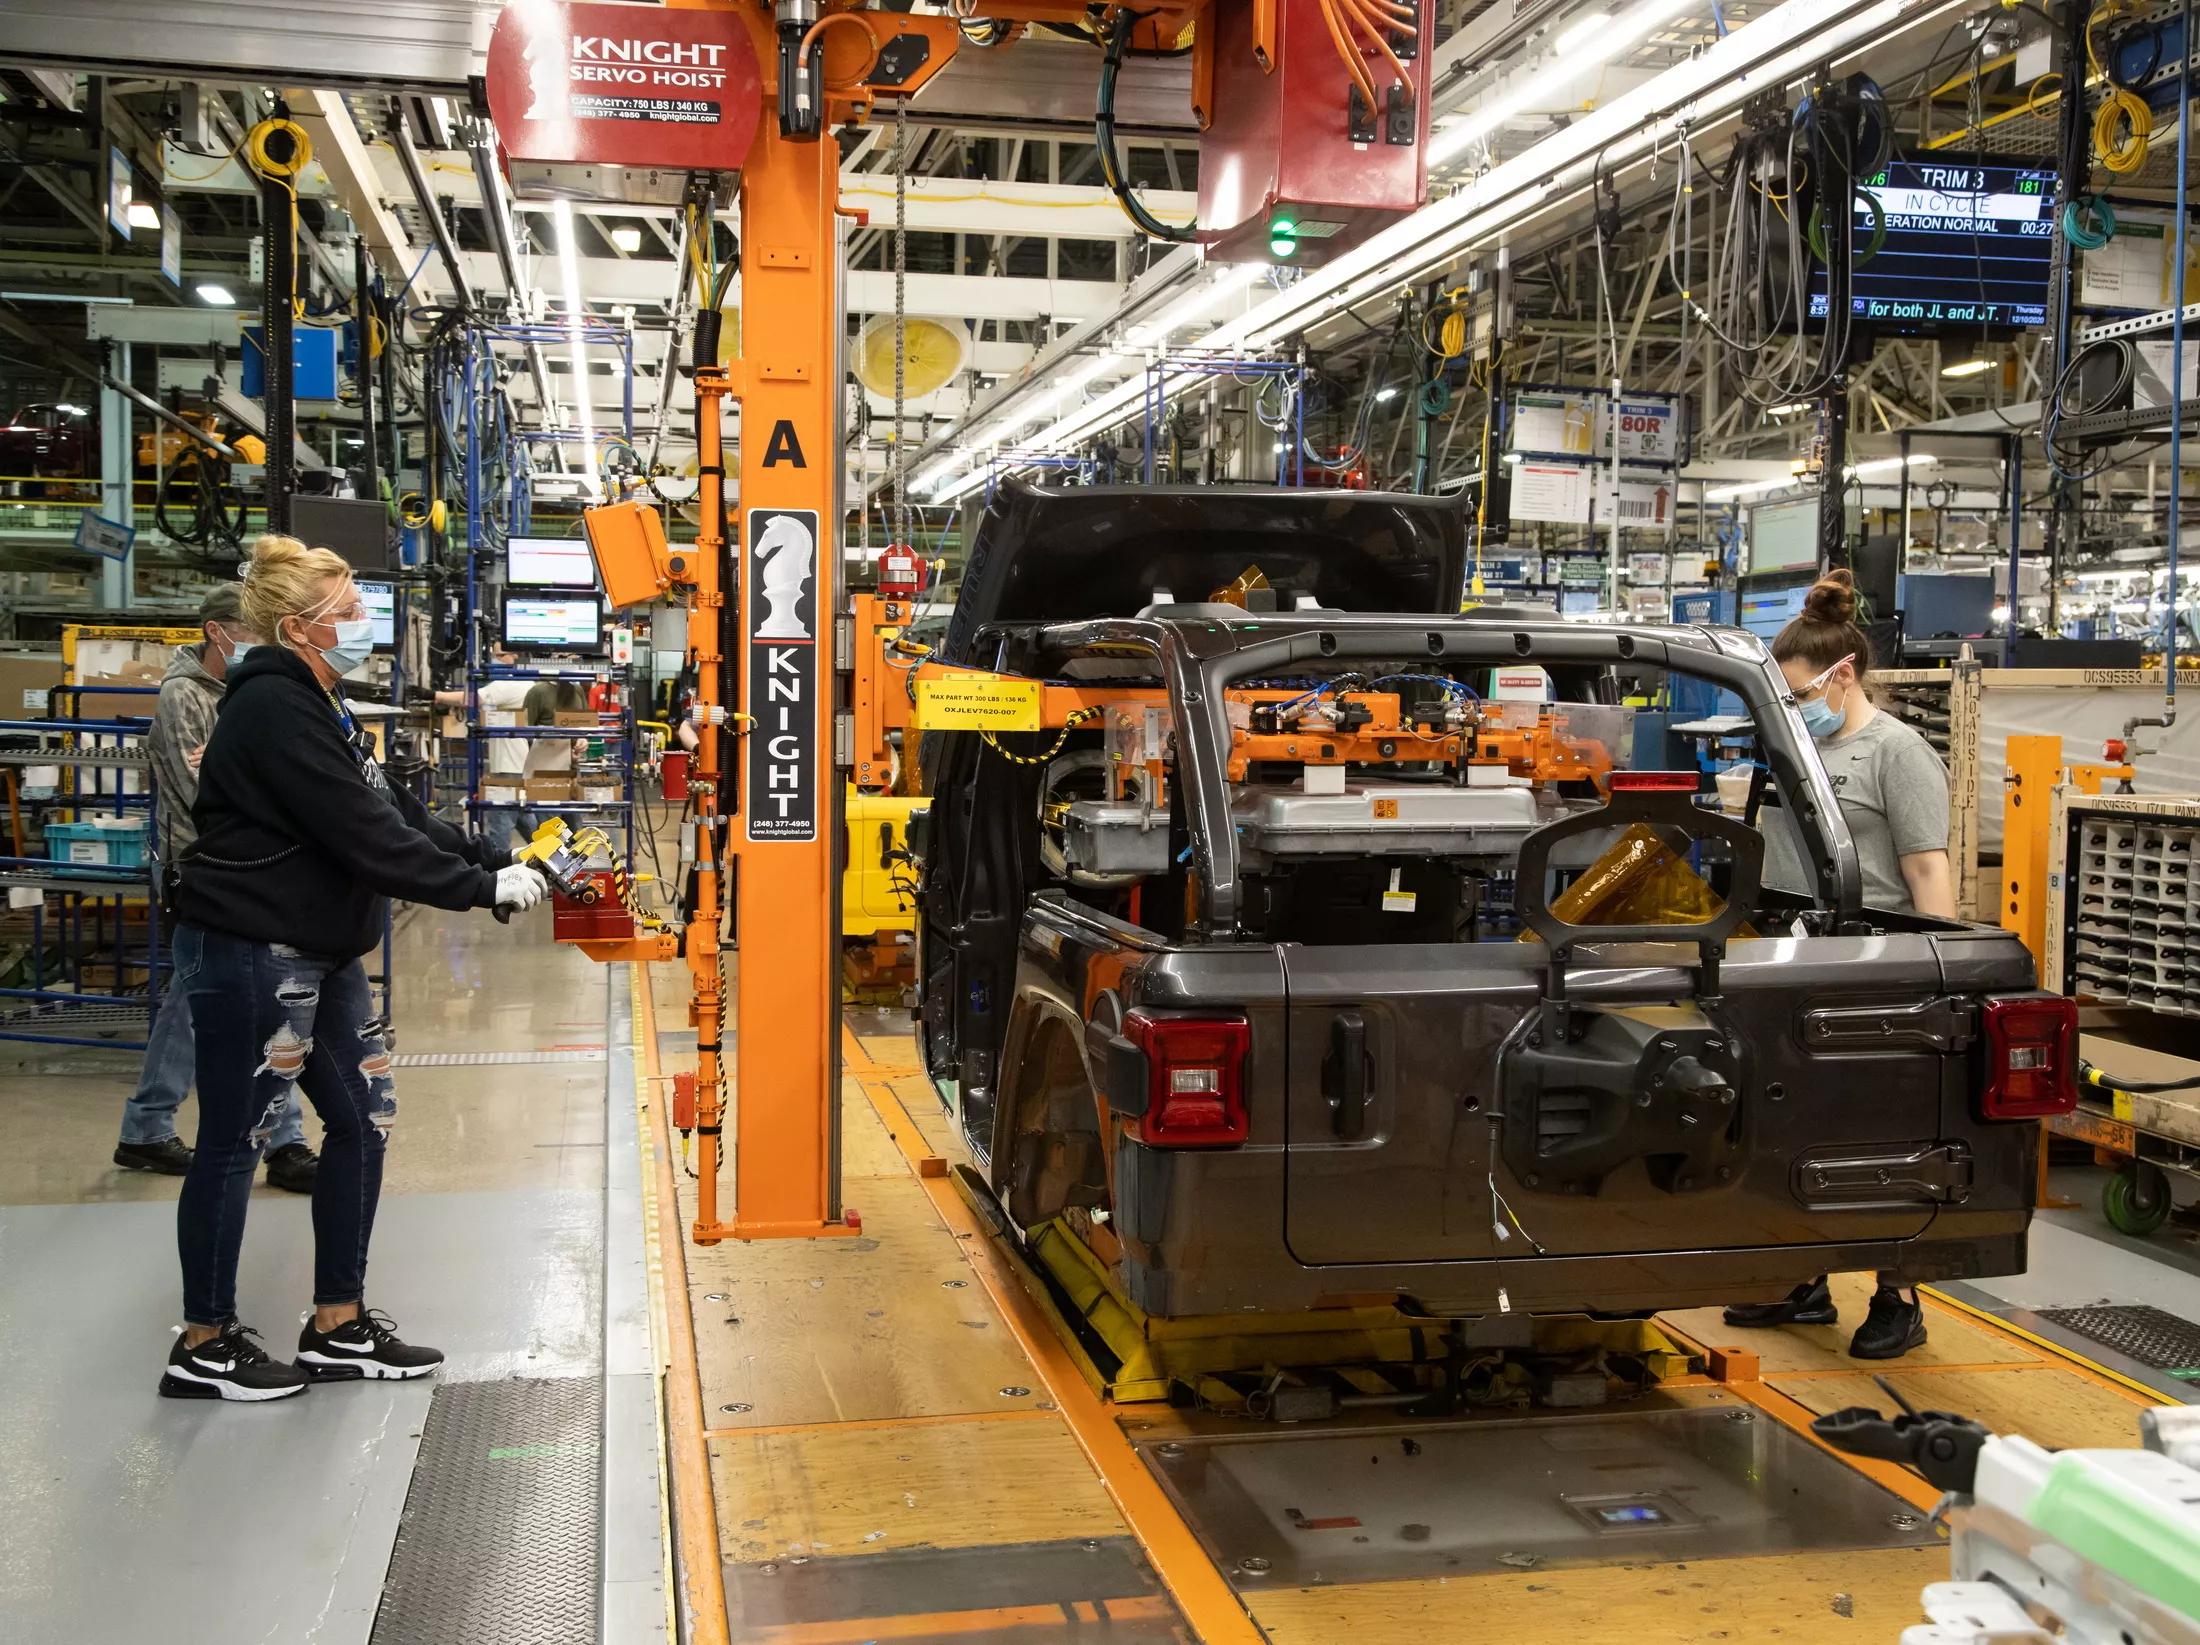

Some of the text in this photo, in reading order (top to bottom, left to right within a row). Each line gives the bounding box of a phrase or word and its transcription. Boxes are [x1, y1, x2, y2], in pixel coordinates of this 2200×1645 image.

[573, 36, 726, 66] KNIGHT
[570, 66, 727, 89] SERVO HOIST
[649, 111, 718, 123] knightglobal.com
[650, 100, 669, 110] LBS
[676, 101, 692, 111] 340
[694, 102, 708, 112] KG
[1921, 168, 1968, 189] TRIM
[1972, 171, 1985, 190] 3
[2020, 180, 2039, 194] 181
[1905, 193, 1992, 214] IN CYCLE
[1865, 213, 2054, 235] OERATION NORMAL 00:27
[1870, 301, 1889, 316] for
[1893, 302, 1924, 317] both
[1927, 304, 1944, 319] JL
[1948, 305, 1975, 320] and
[762, 420, 807, 468] A
[767, 647, 800, 817] KNIGHT
[1967, 684, 1977, 809] LOADSIDE
[753, 820, 773, 828] (248)
